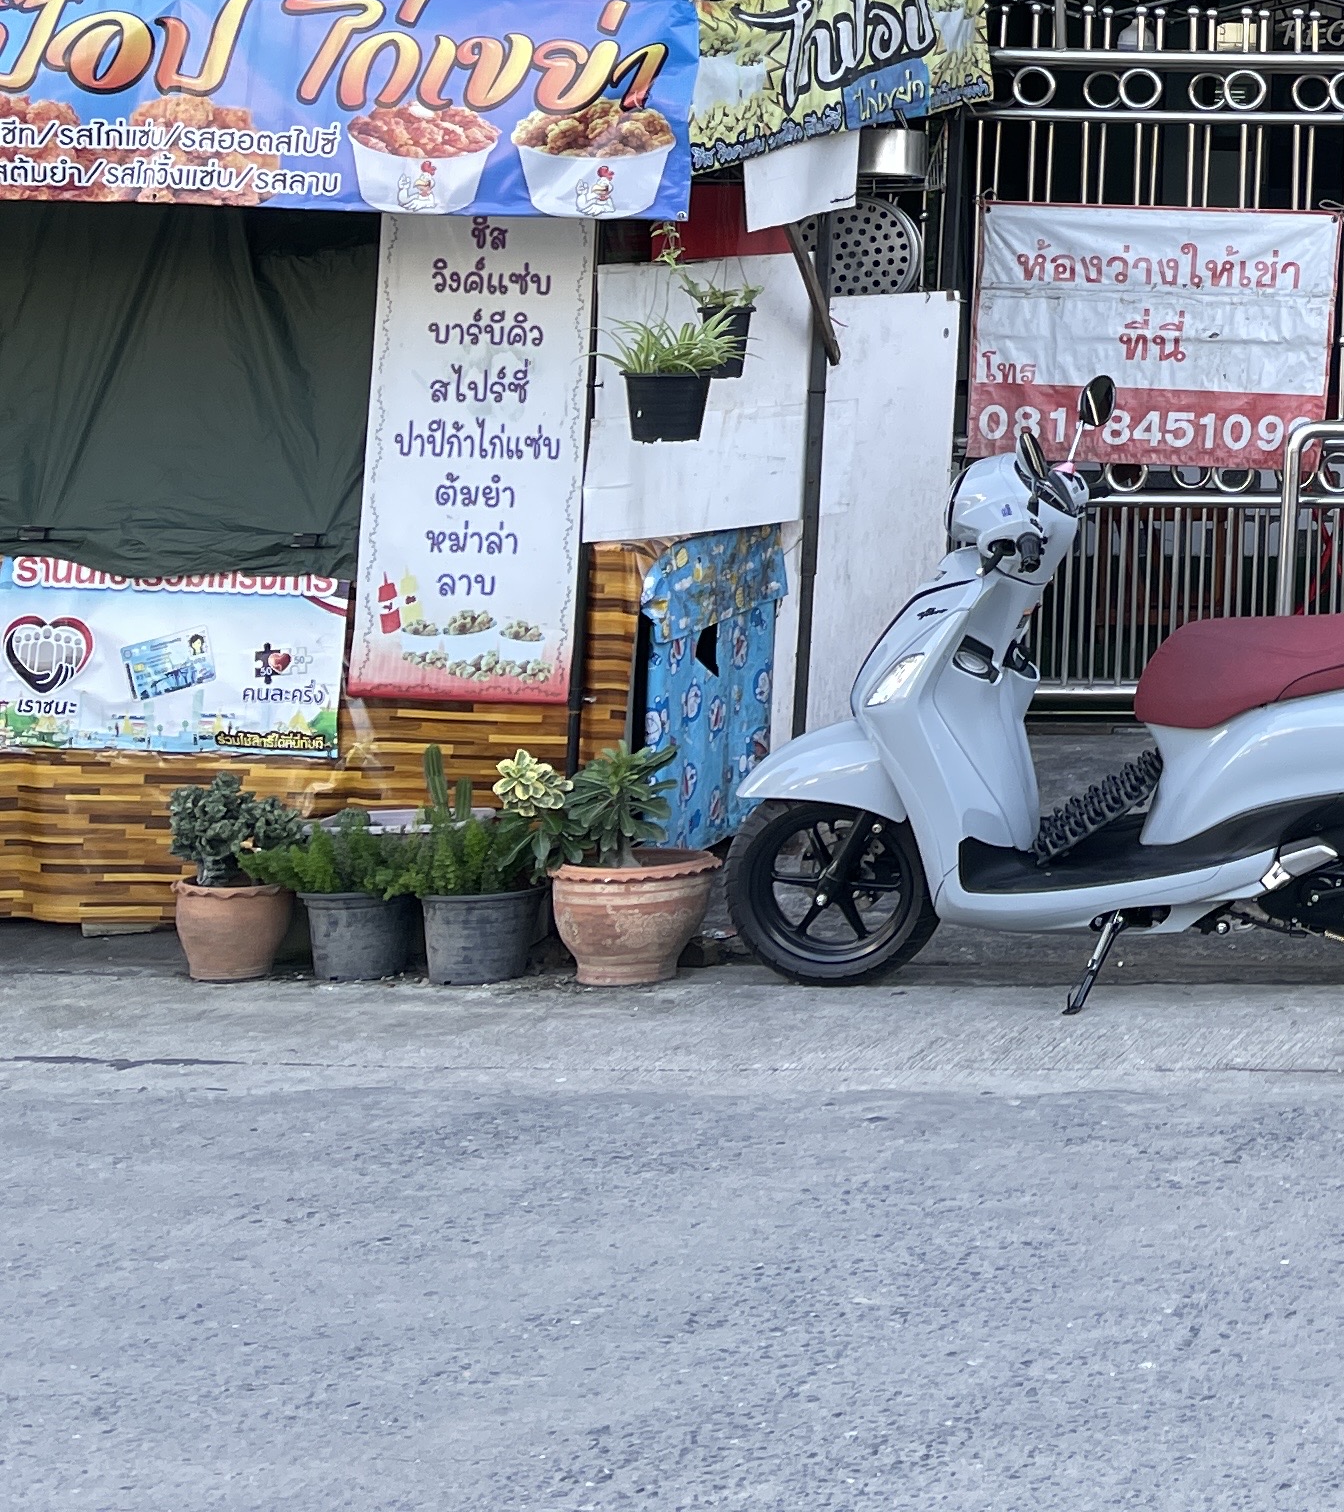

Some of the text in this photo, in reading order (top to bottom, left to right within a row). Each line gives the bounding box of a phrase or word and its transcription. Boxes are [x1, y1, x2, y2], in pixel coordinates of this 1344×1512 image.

[1016, 238, 1301, 290] ห้องว่างให้เช่า
[427, 308, 545, 349] บาร์บีคิว
[1118, 308, 1187, 364] ที่นี่
[981, 351, 1036, 384] โทร
[434, 471, 516, 509] ต้มยำ
[425, 521, 519, 556] หม่าล่า
[437, 569, 497, 598] ลาบ
[17, 698, 77, 715] เราชนะ
[243, 679, 324, 704] คนละครึ่ง
